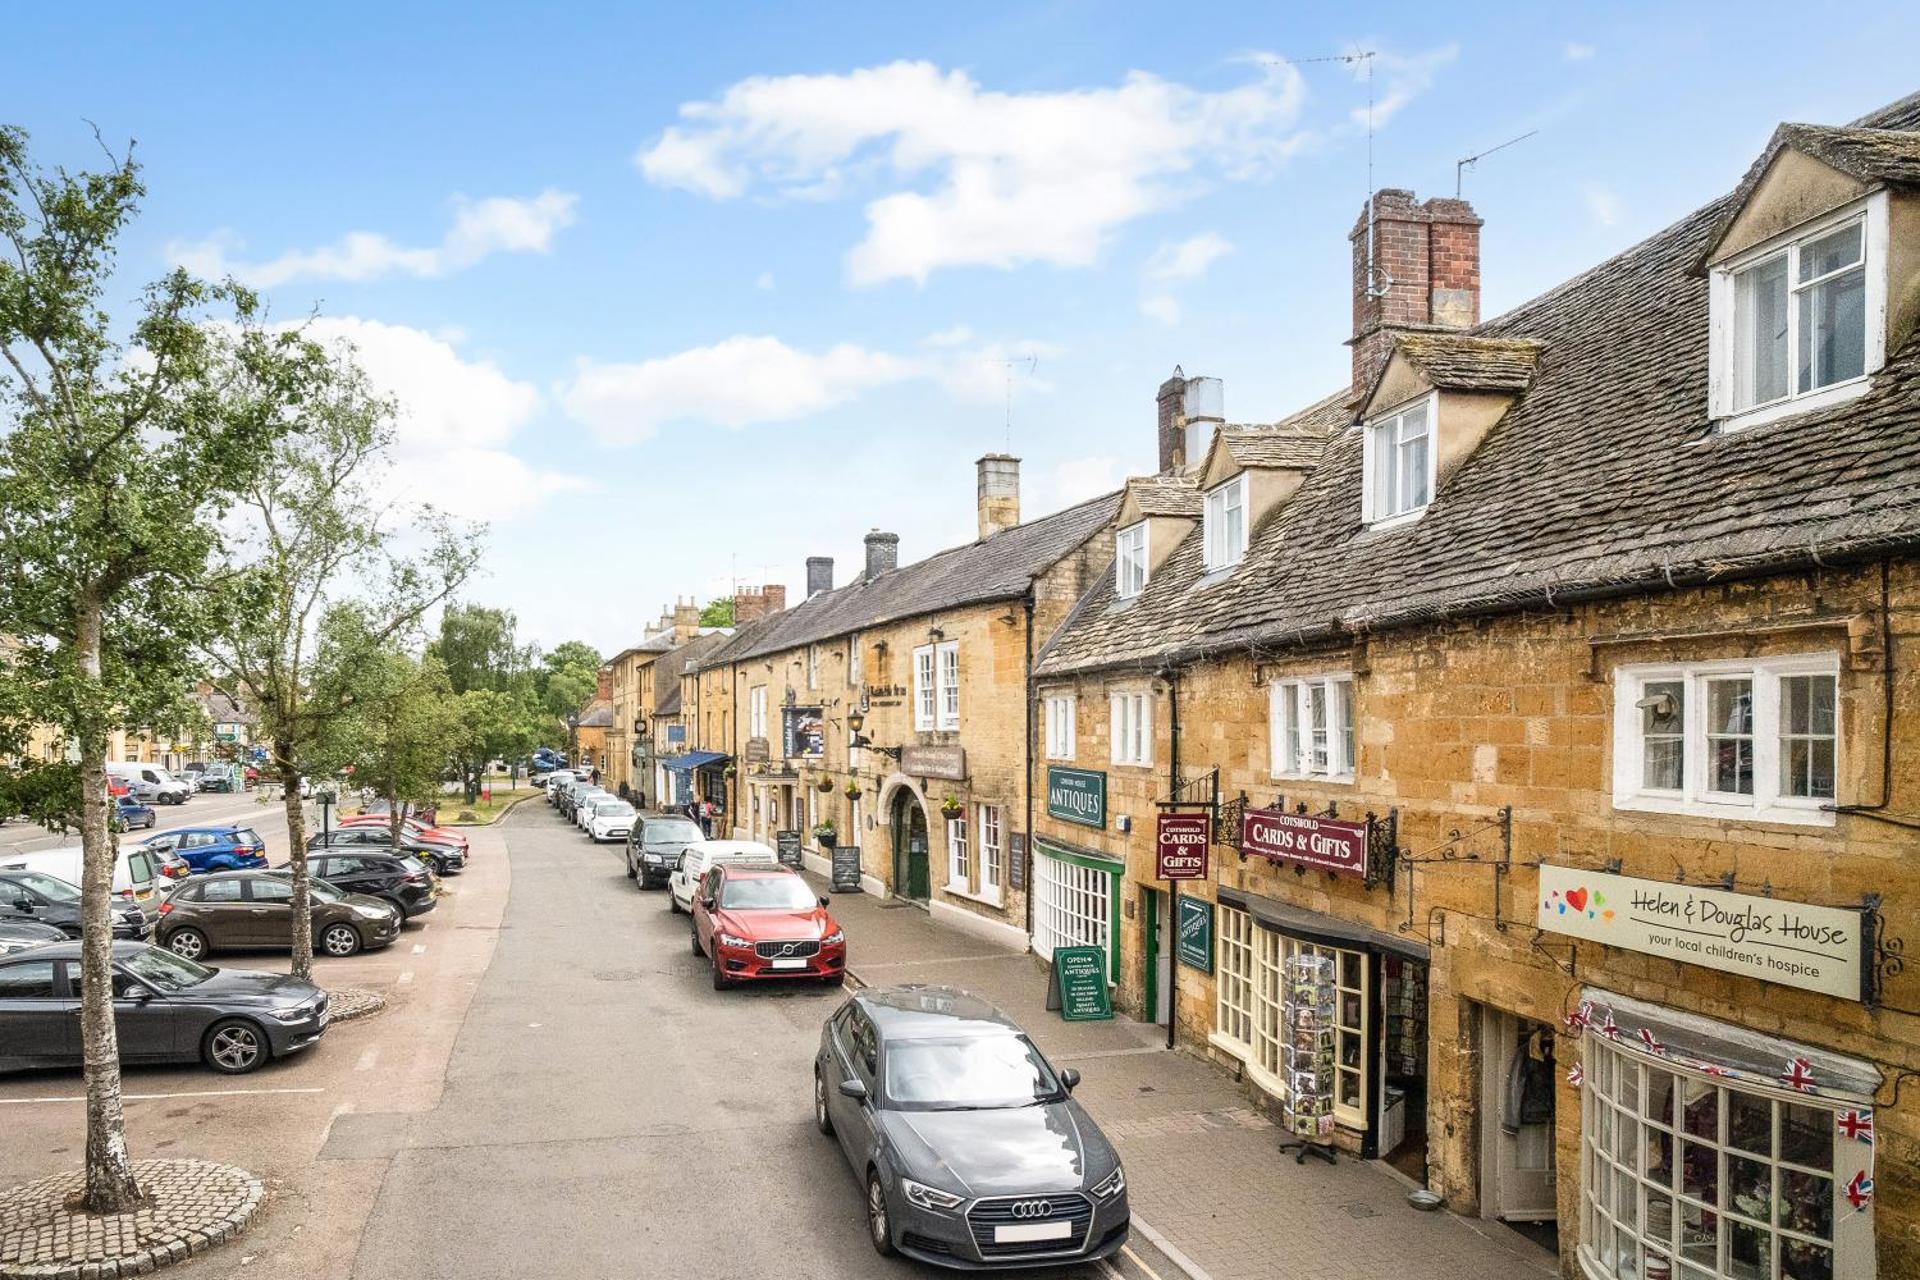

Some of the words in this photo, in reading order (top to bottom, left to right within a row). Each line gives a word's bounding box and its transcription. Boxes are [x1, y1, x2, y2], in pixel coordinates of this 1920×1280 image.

[1051, 786, 1099, 815] ANTIQUES
[1279, 815, 1319, 831] COTSWOLD
[1177, 845, 1189, 856] &
[1296, 834, 1308, 851] &
[1630, 889, 1679, 917] Helen
[1683, 894, 1697, 925] &
[1700, 900, 1773, 943] Douglas
[1777, 914, 1848, 945] House
[1066, 956, 1087, 964] OPEN
[1648, 933, 1672, 946] your
[1674, 936, 1701, 953] local
[1705, 943, 1764, 967] children's
[1767, 955, 1821, 978] hospice
